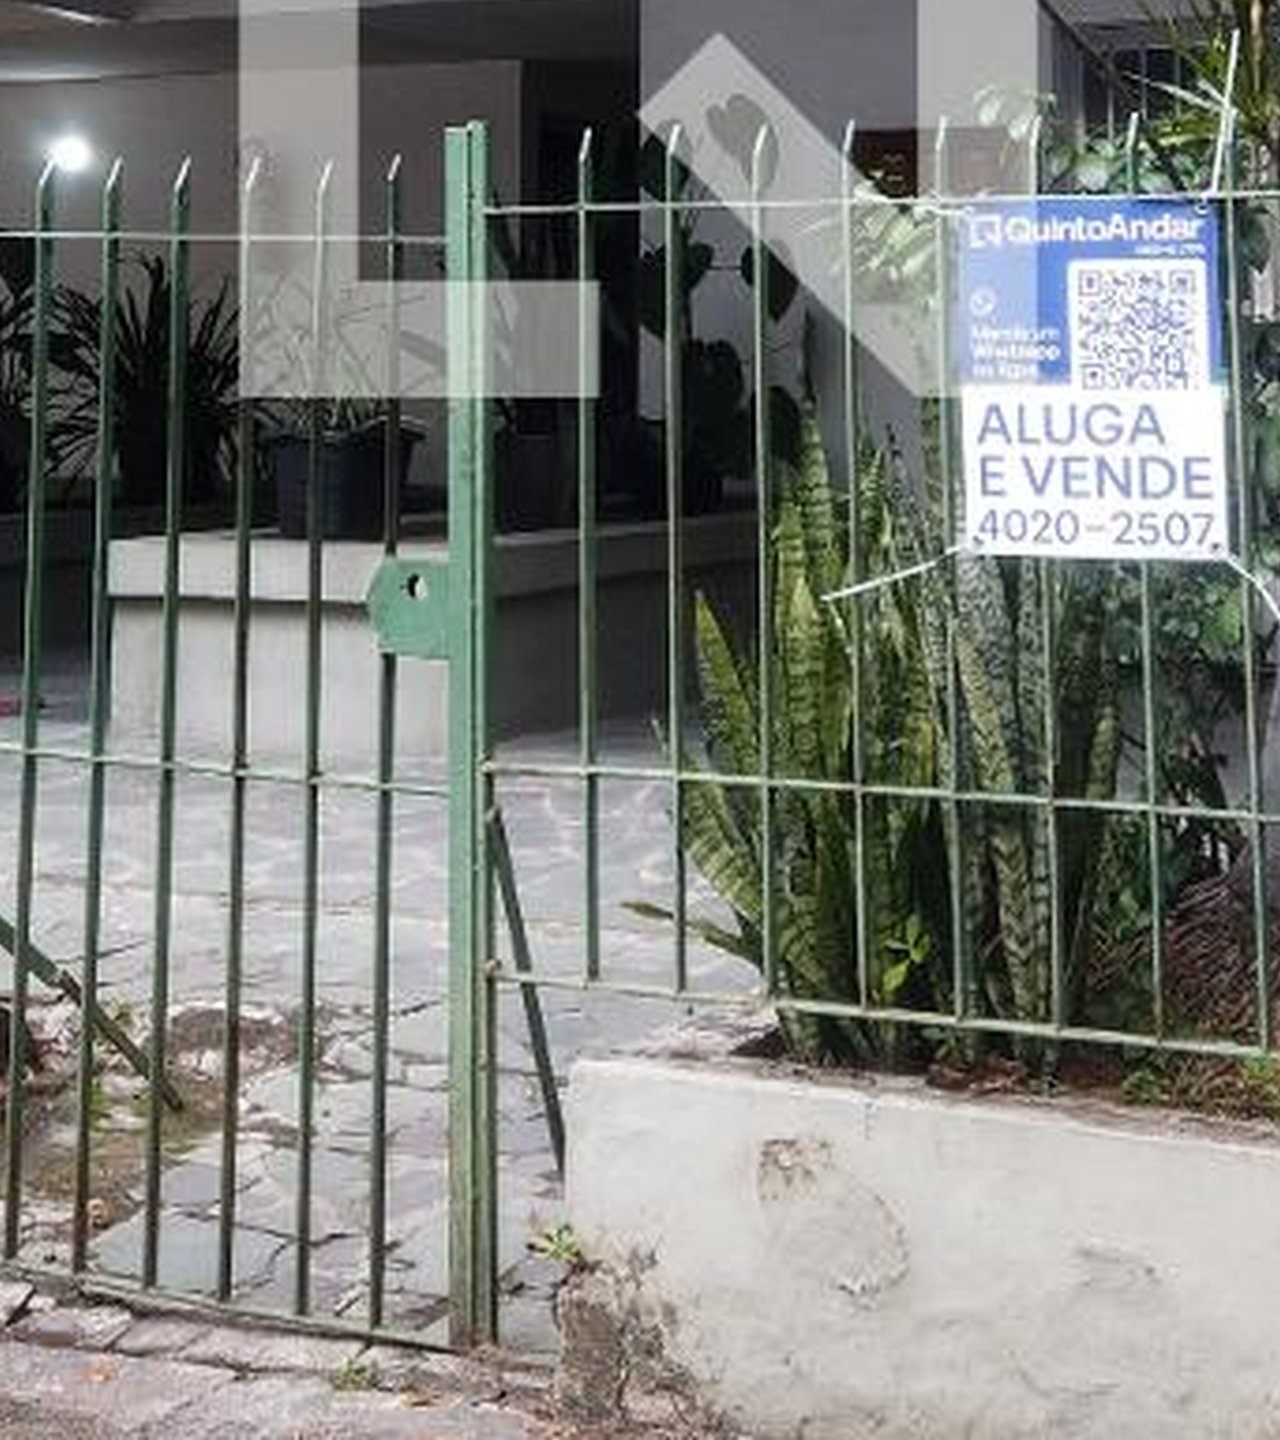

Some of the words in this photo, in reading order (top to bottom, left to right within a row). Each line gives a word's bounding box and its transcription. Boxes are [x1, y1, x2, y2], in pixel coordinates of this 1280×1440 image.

[1005, 213, 1205, 242] QuintoAndar
[976, 402, 1167, 446] ALUGA
[980, 456, 1007, 497] E
[1021, 456, 1214, 500] VENDE
[978, 509, 1216, 547] 4020-2507
